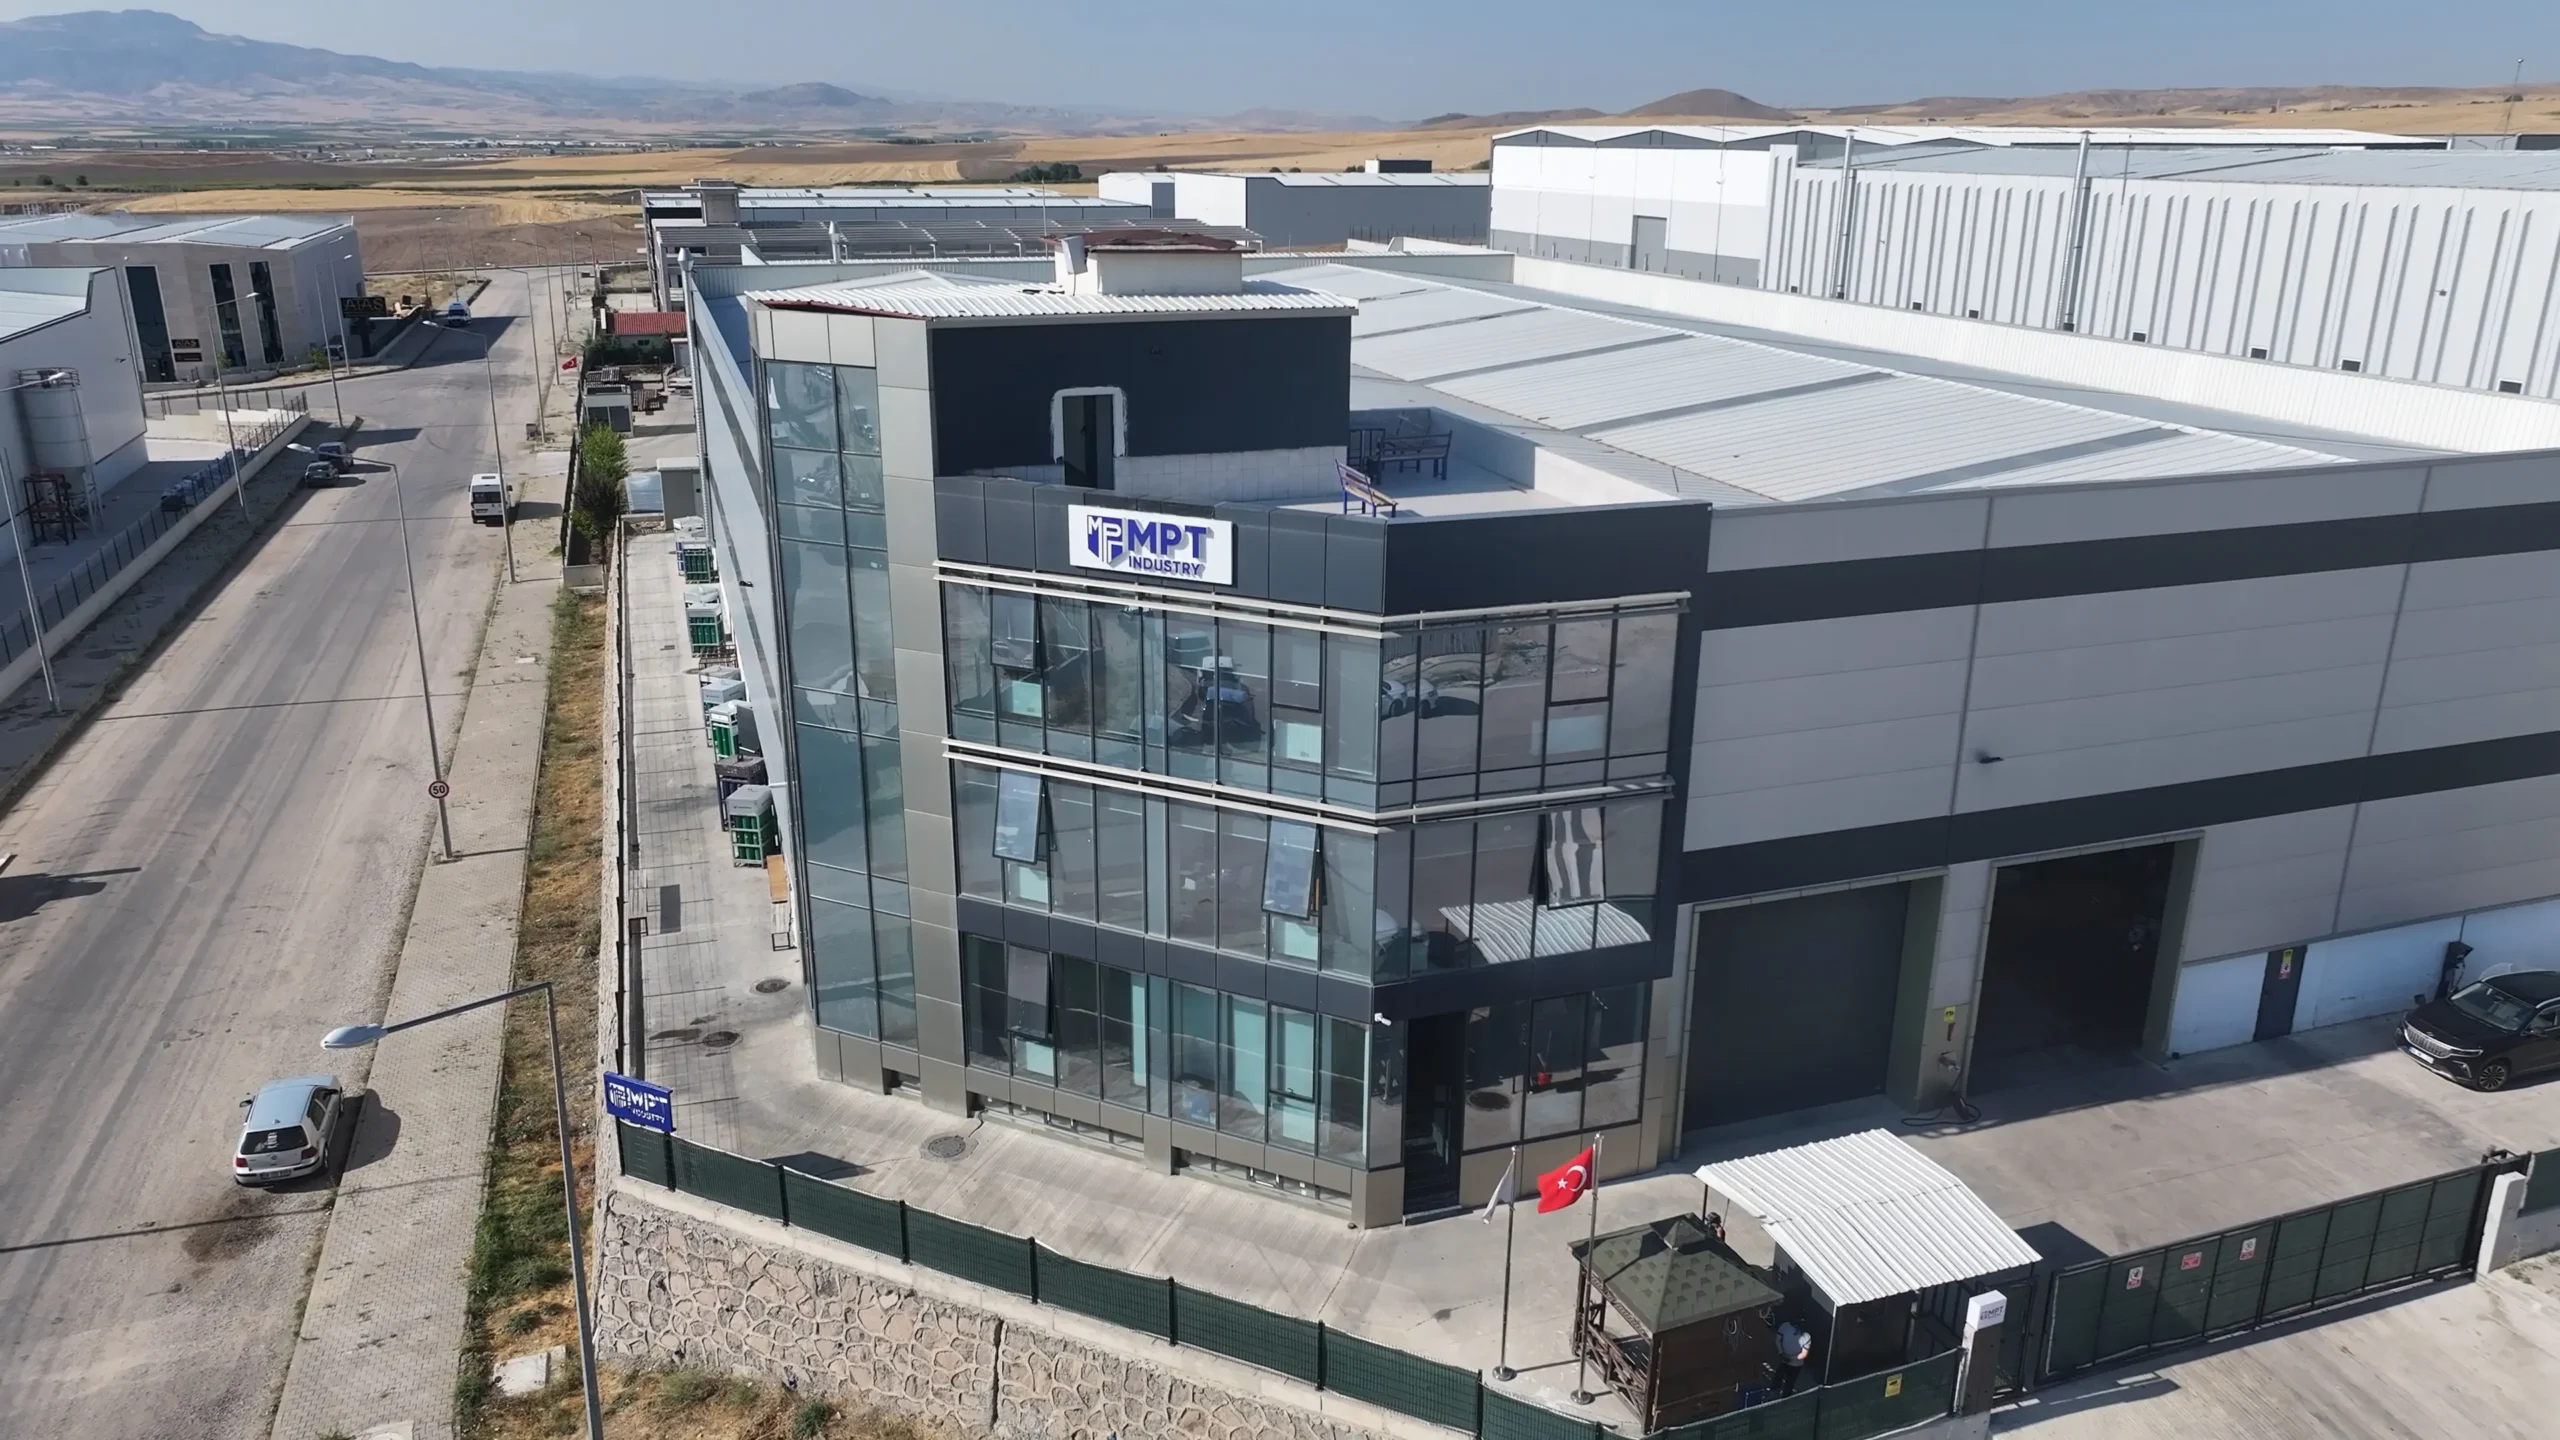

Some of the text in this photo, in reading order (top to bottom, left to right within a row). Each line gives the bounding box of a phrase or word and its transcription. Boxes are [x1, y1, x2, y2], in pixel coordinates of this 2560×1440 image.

[1128, 519, 1209, 561] MPT
[1128, 555, 1201, 576] INDUSTRY
[433, 785, 445, 794] 50
[626, 1087, 668, 1112] MPT
[1988, 1305, 2004, 1316] MPT
